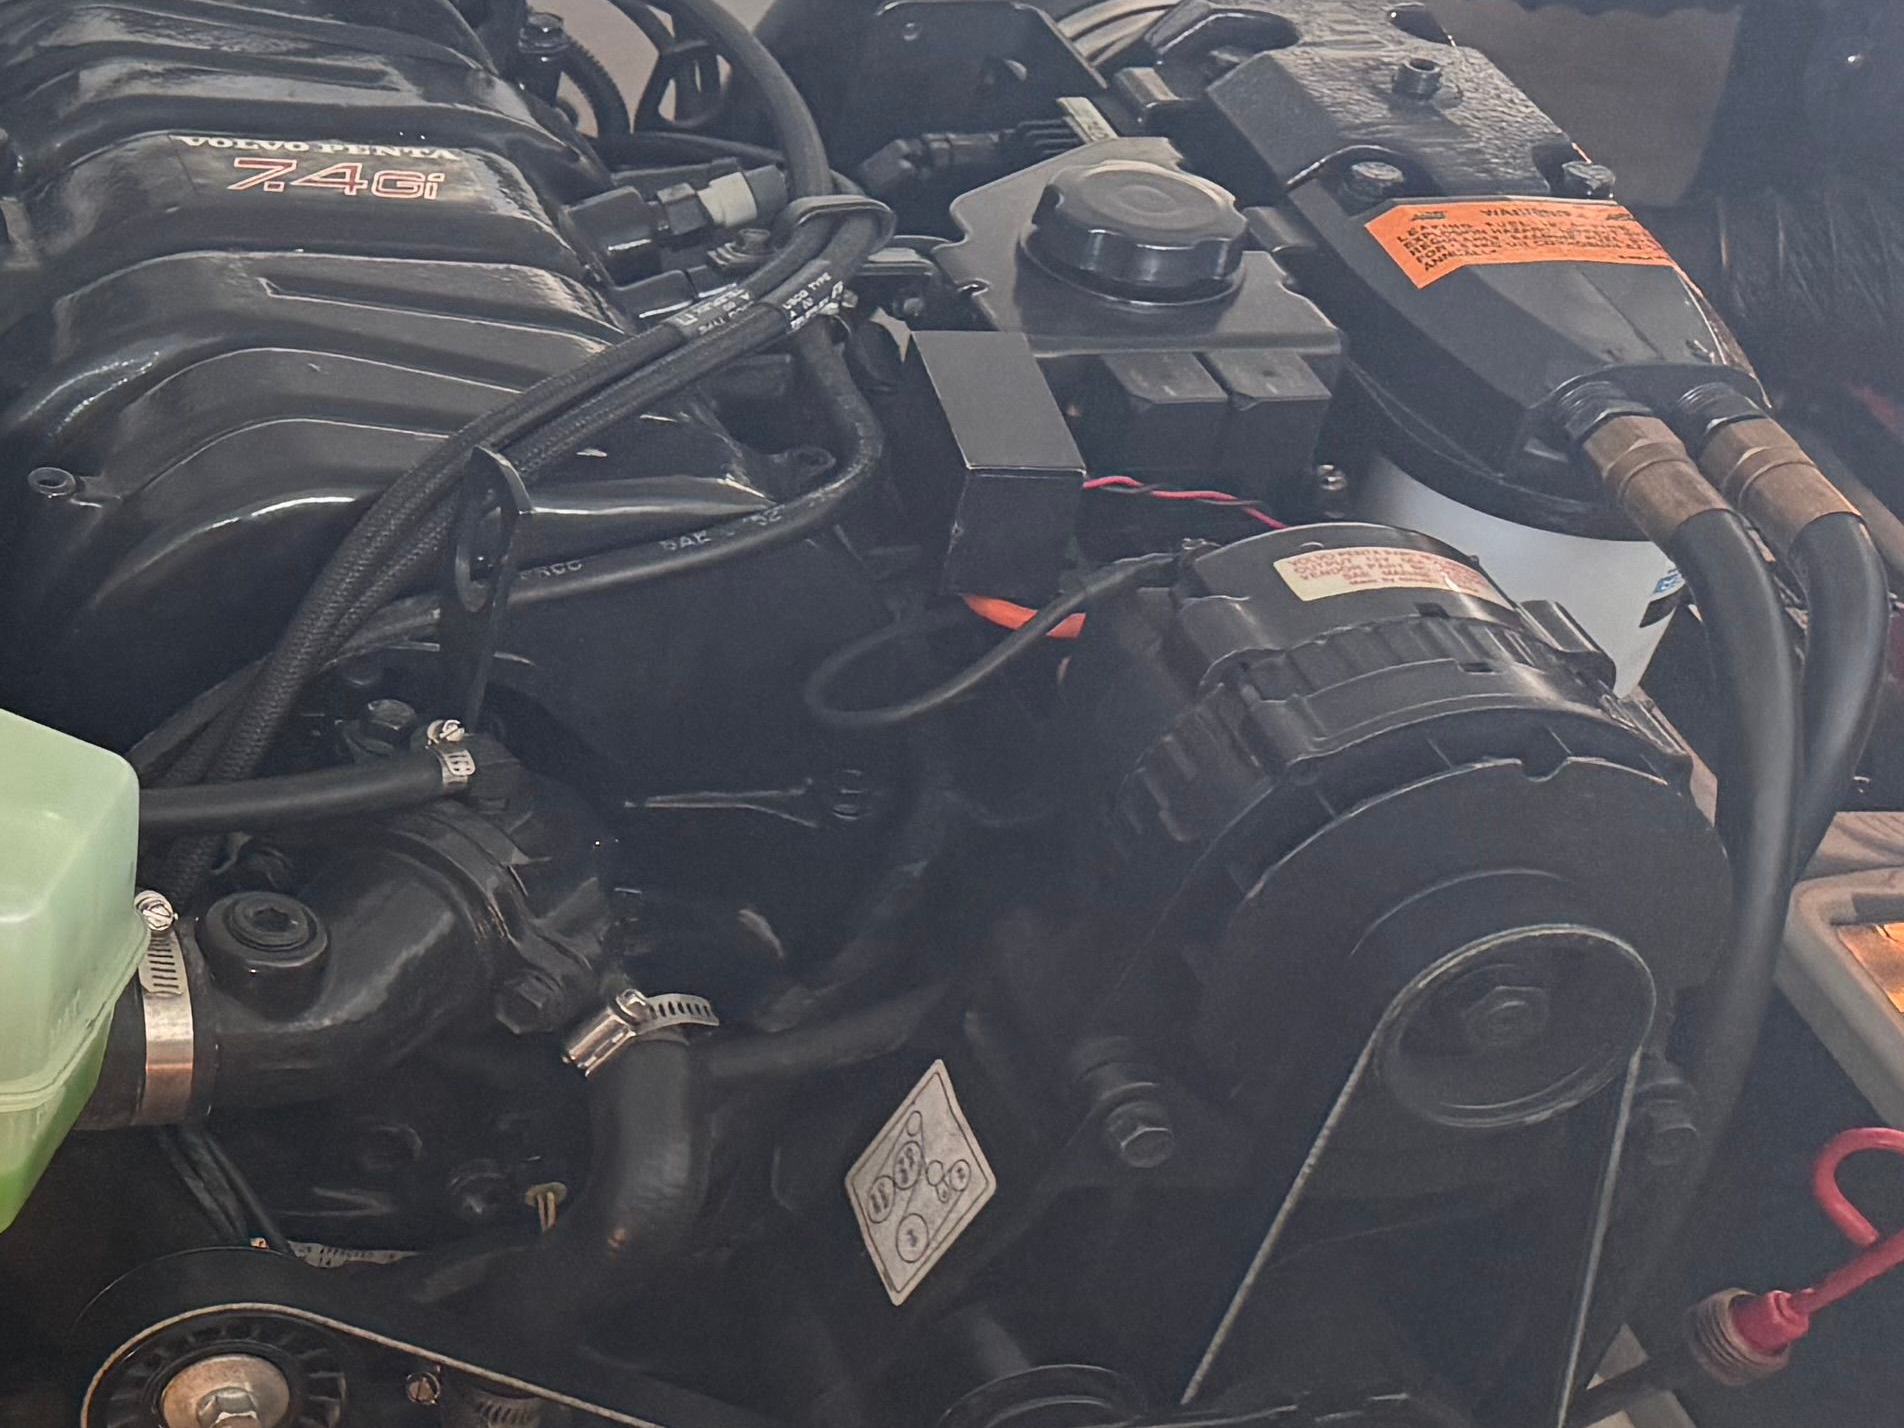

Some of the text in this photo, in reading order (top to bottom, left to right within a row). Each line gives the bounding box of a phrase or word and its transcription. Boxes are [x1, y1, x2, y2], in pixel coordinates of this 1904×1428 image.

[177, 135, 461, 161] VOLVO PENTA
[226, 157, 446, 200] 7.4Gi
